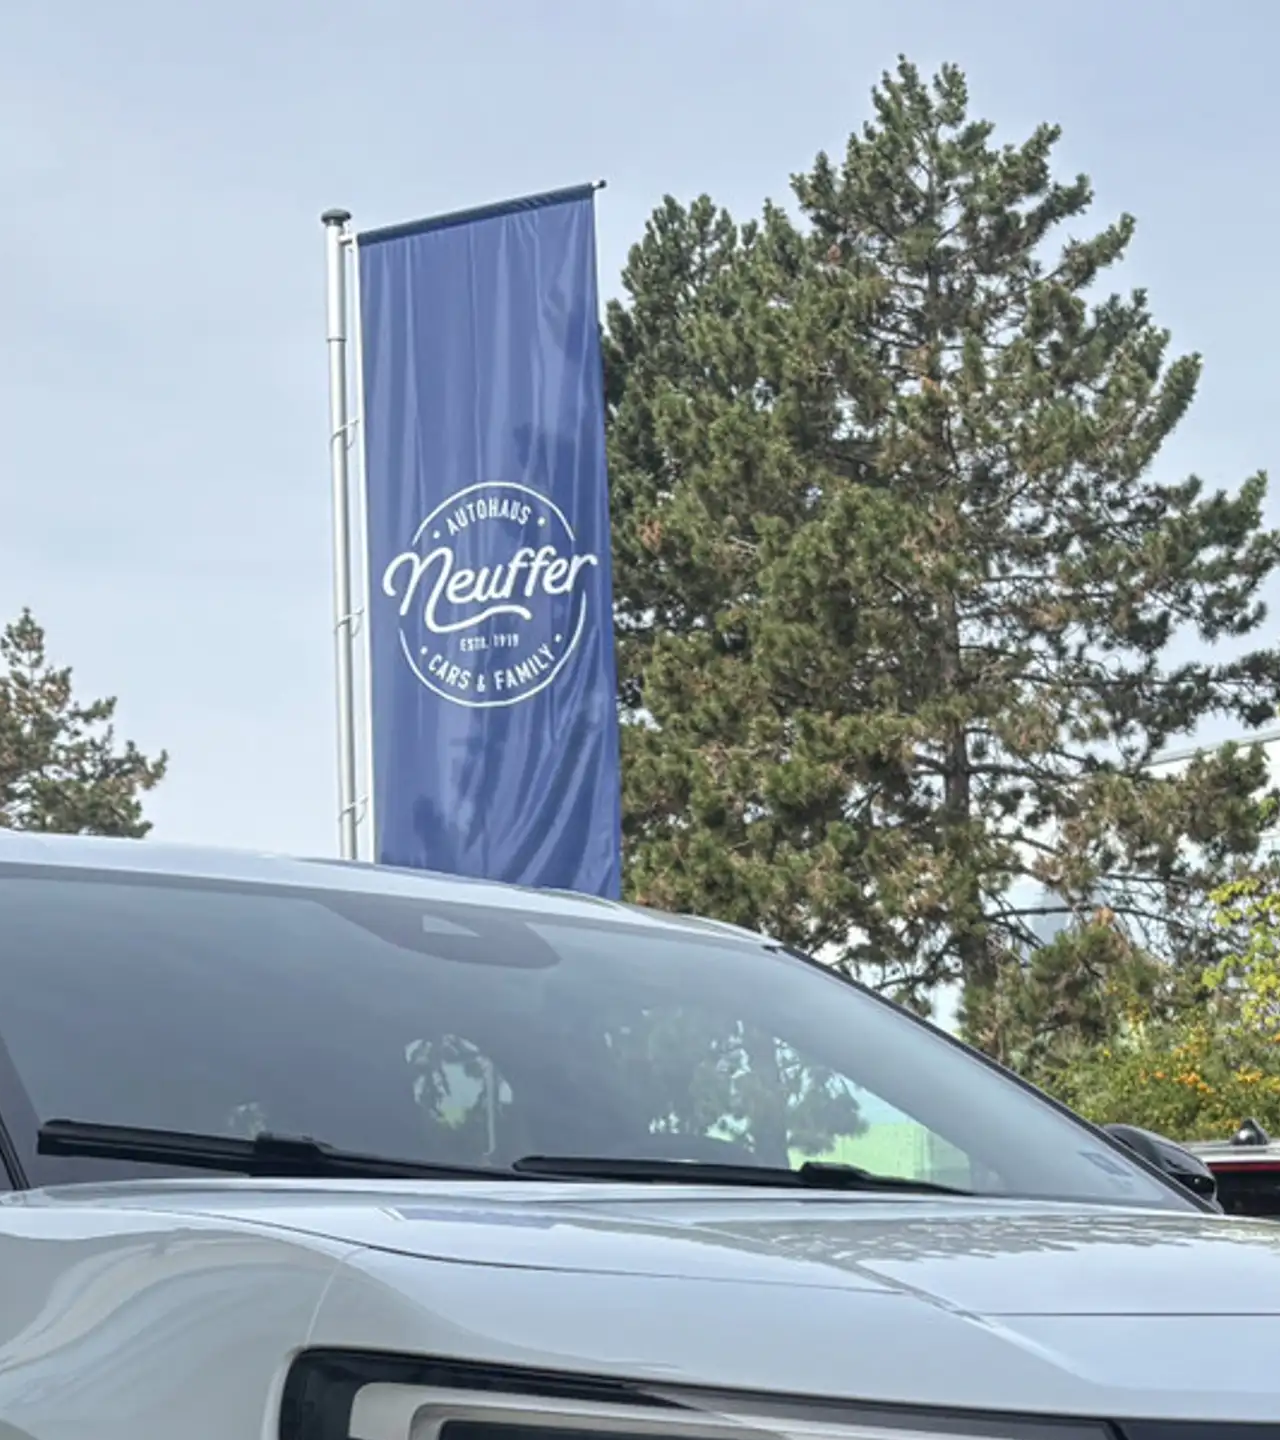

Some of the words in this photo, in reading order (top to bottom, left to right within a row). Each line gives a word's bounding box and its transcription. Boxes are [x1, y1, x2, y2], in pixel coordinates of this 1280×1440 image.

[445, 497, 532, 537] AUTOHAUS
[382, 545, 598, 633] Neuffer
[428, 653, 471, 691] CARS
[477, 673, 486, 692] &
[494, 644, 556, 691] FAMILY
